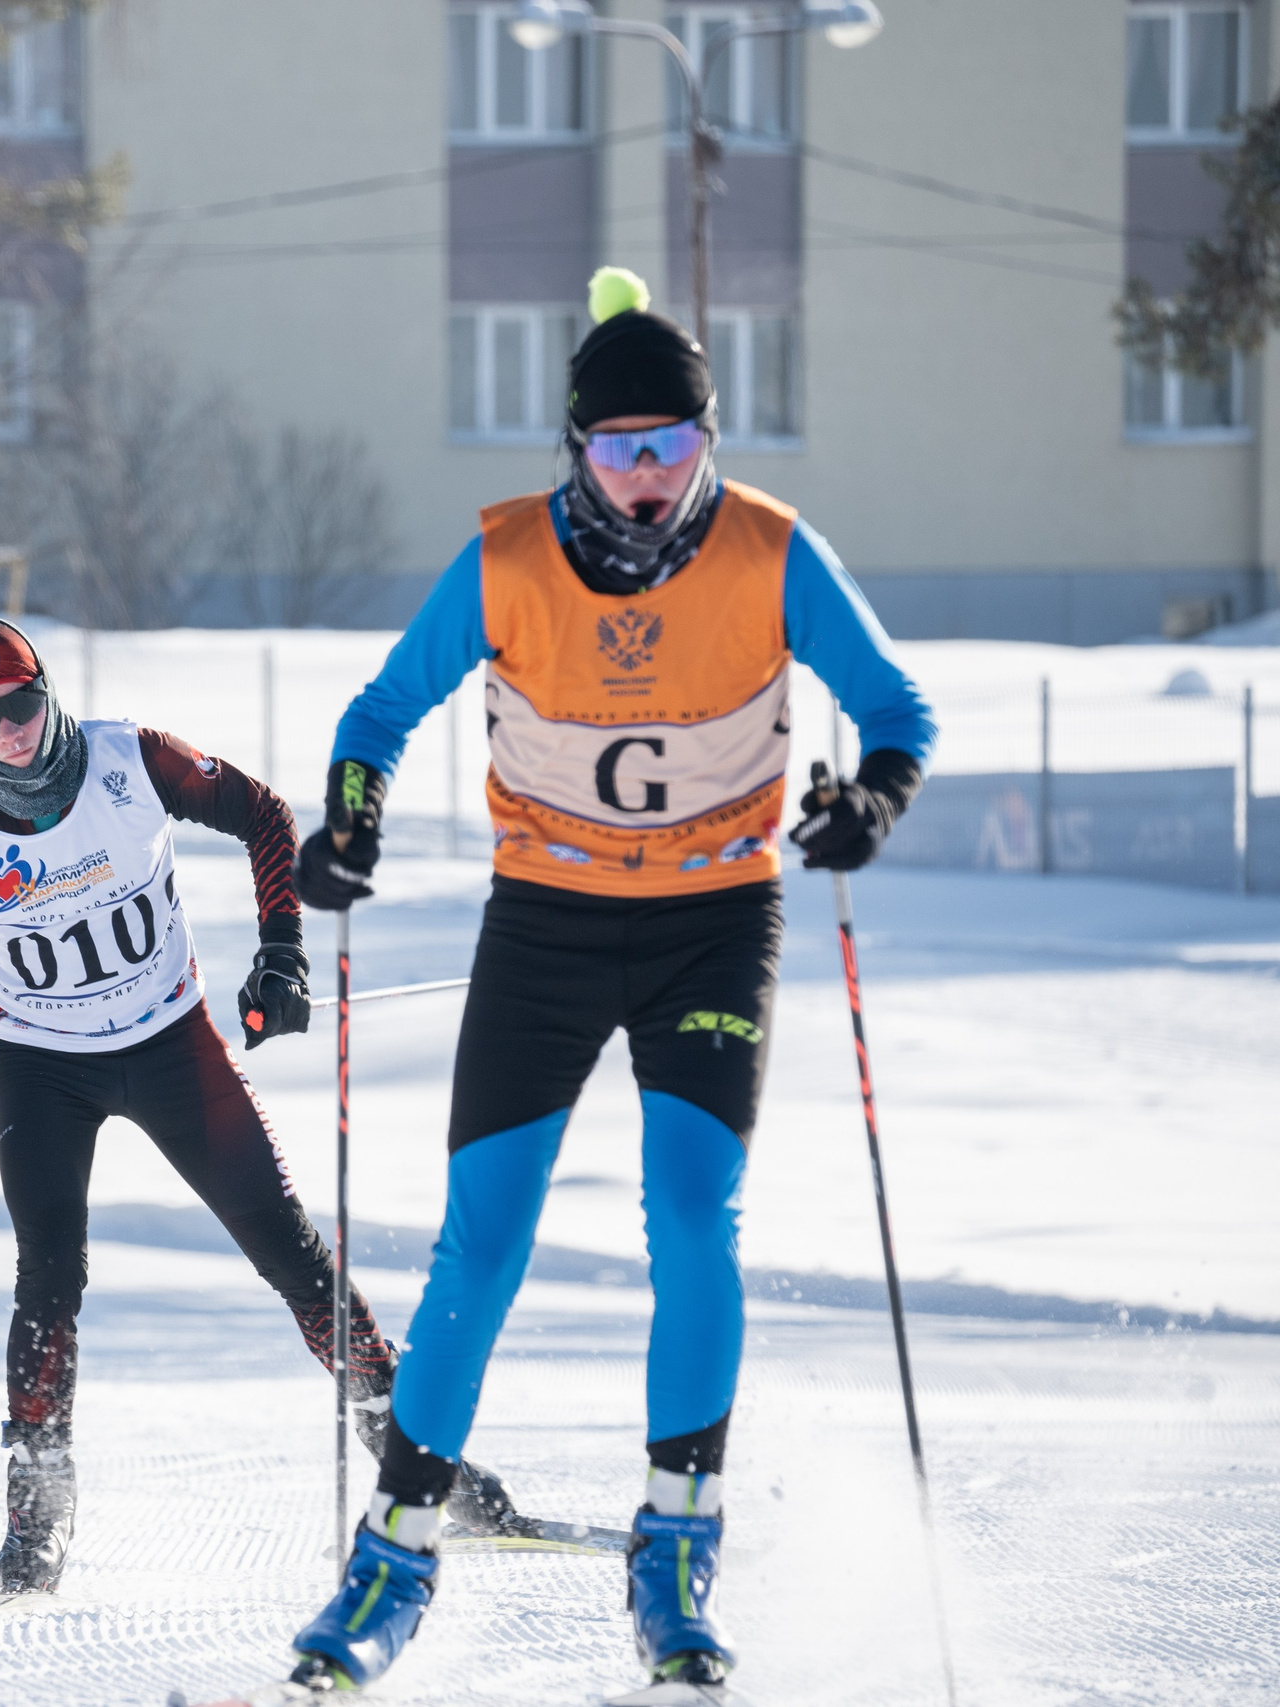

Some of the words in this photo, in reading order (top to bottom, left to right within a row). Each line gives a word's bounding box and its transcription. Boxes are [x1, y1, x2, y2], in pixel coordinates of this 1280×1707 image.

[595, 736, 668, 812] G
[19, 863, 112, 904] СПАРТАКИАДА
[37, 854, 110, 890] ЗИМНЯЯ
[21, 884, 92, 914] ИНВАЛИДОВ
[7, 892, 156, 991] 010
